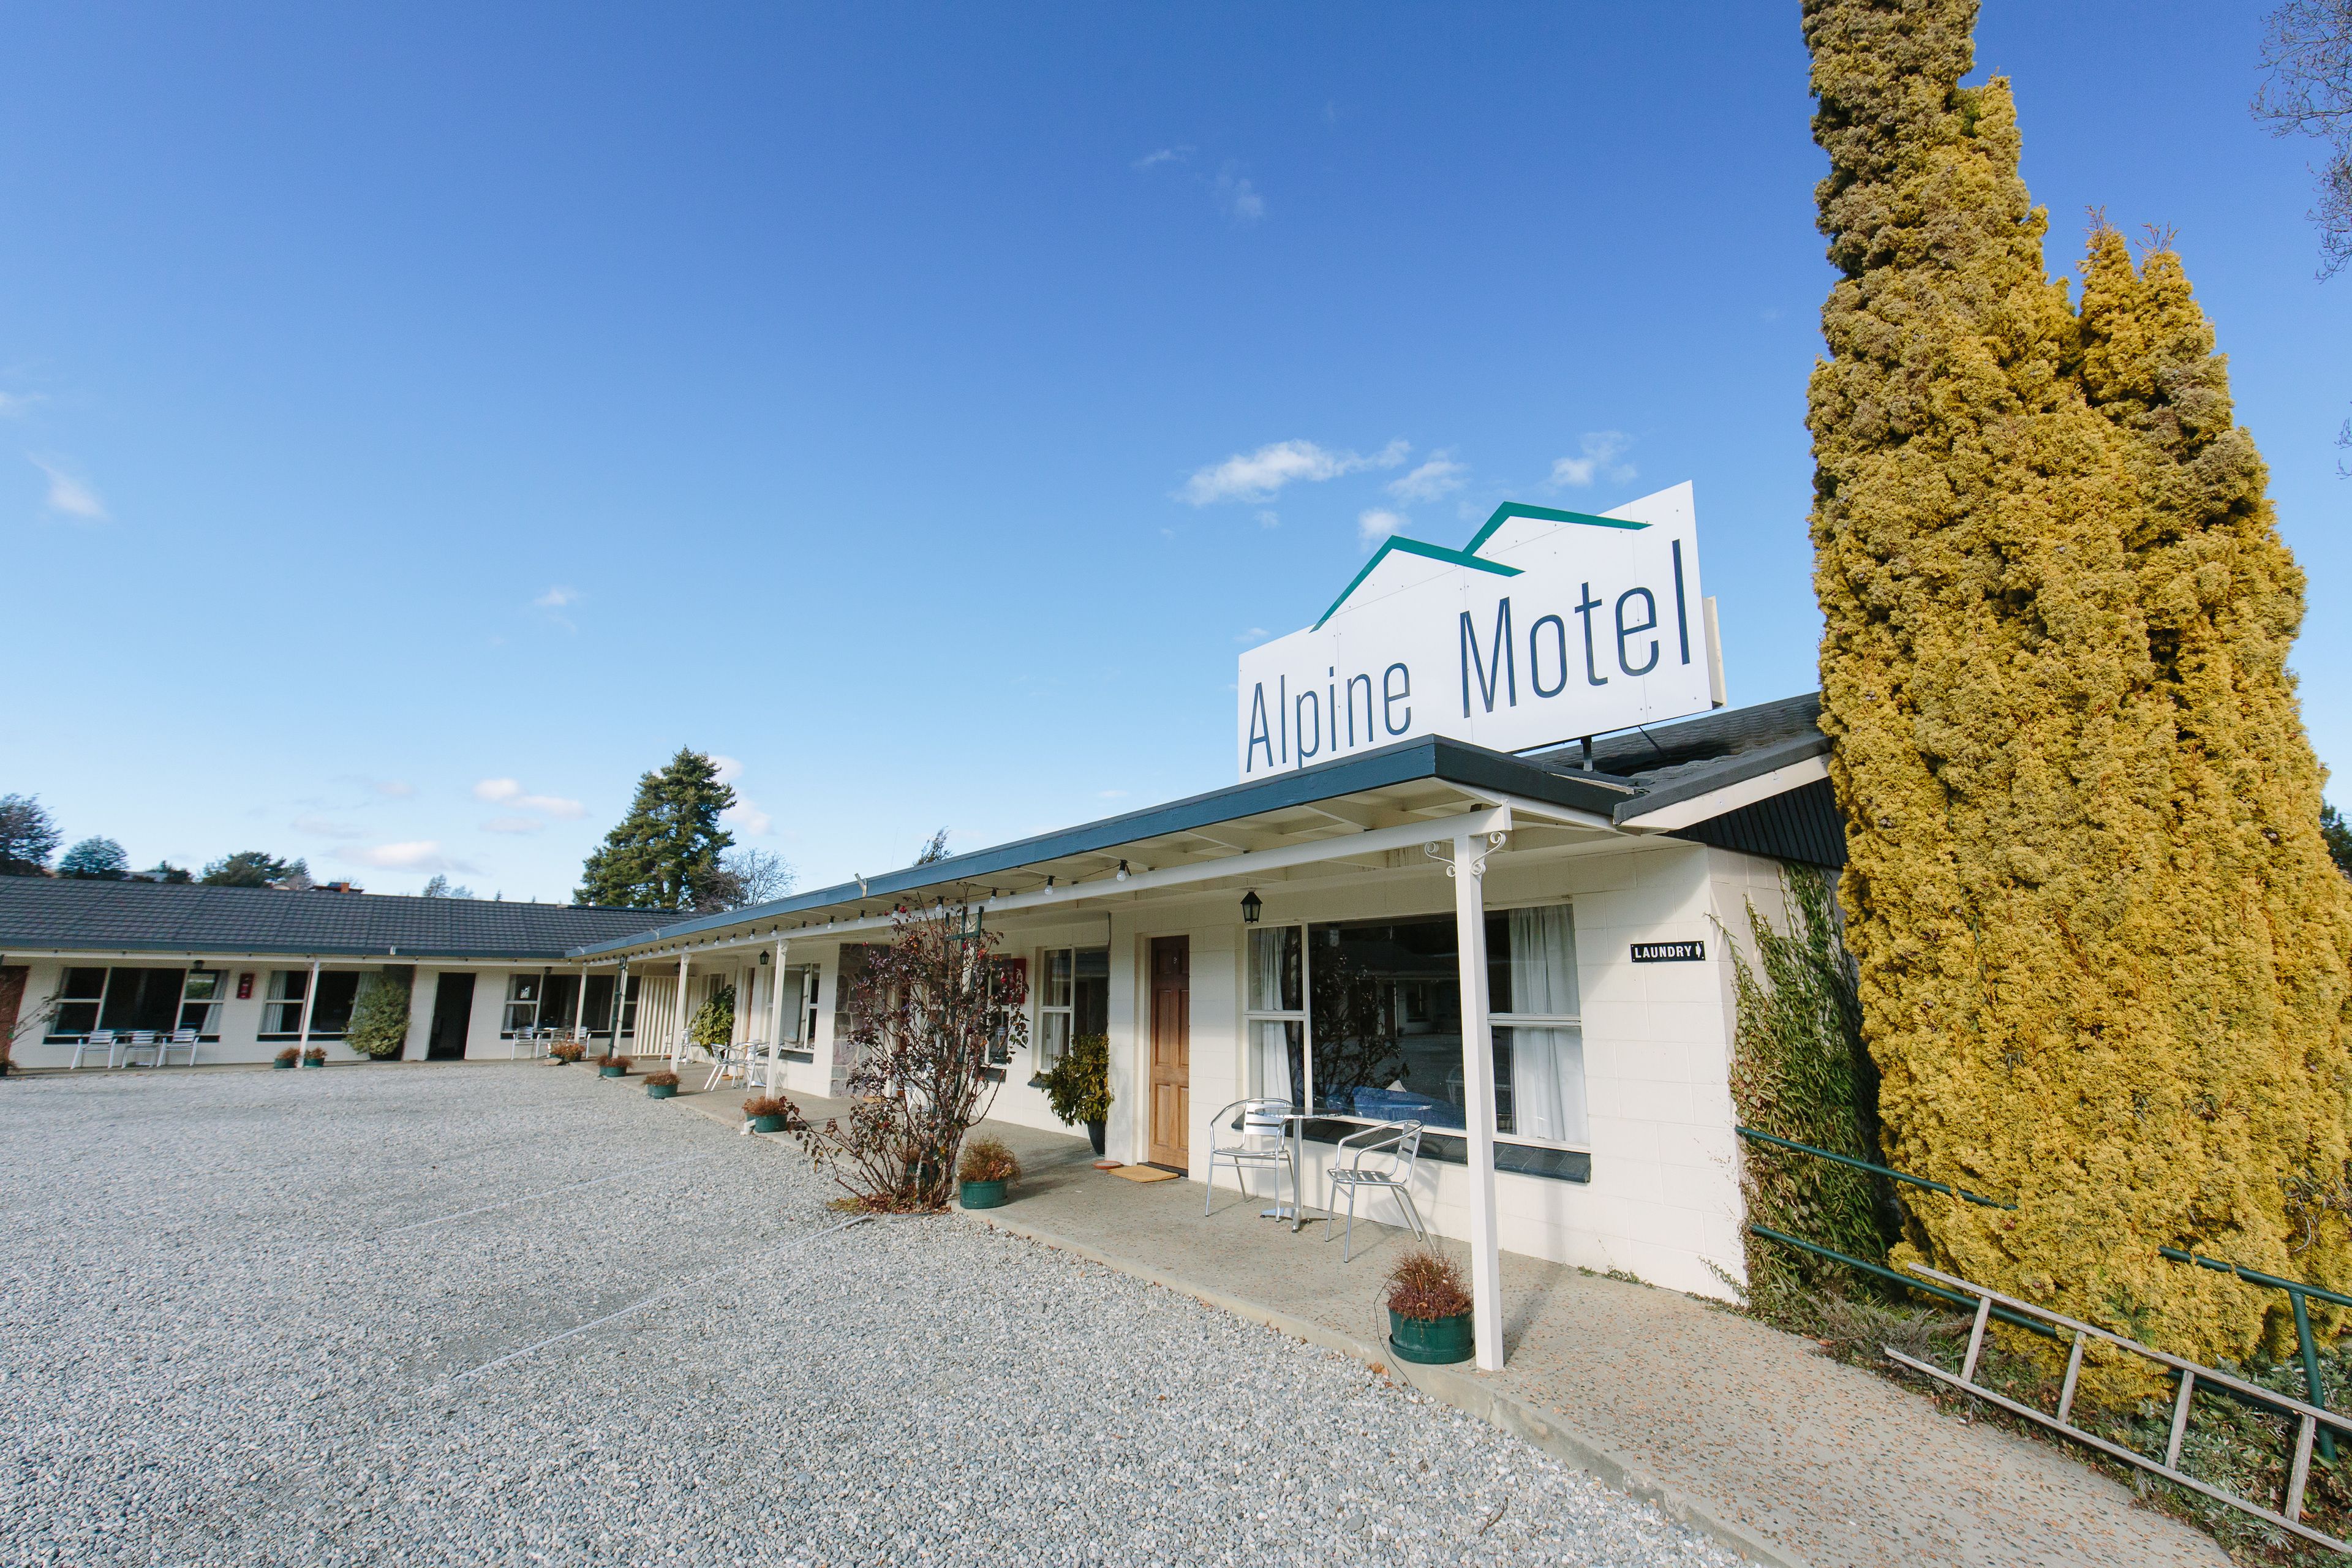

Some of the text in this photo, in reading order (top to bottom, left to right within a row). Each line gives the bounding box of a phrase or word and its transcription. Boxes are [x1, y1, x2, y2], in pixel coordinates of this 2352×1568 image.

[1246, 538, 1691, 773] Alpine Motel
[1634, 945, 1692, 959] LAUNDRY
